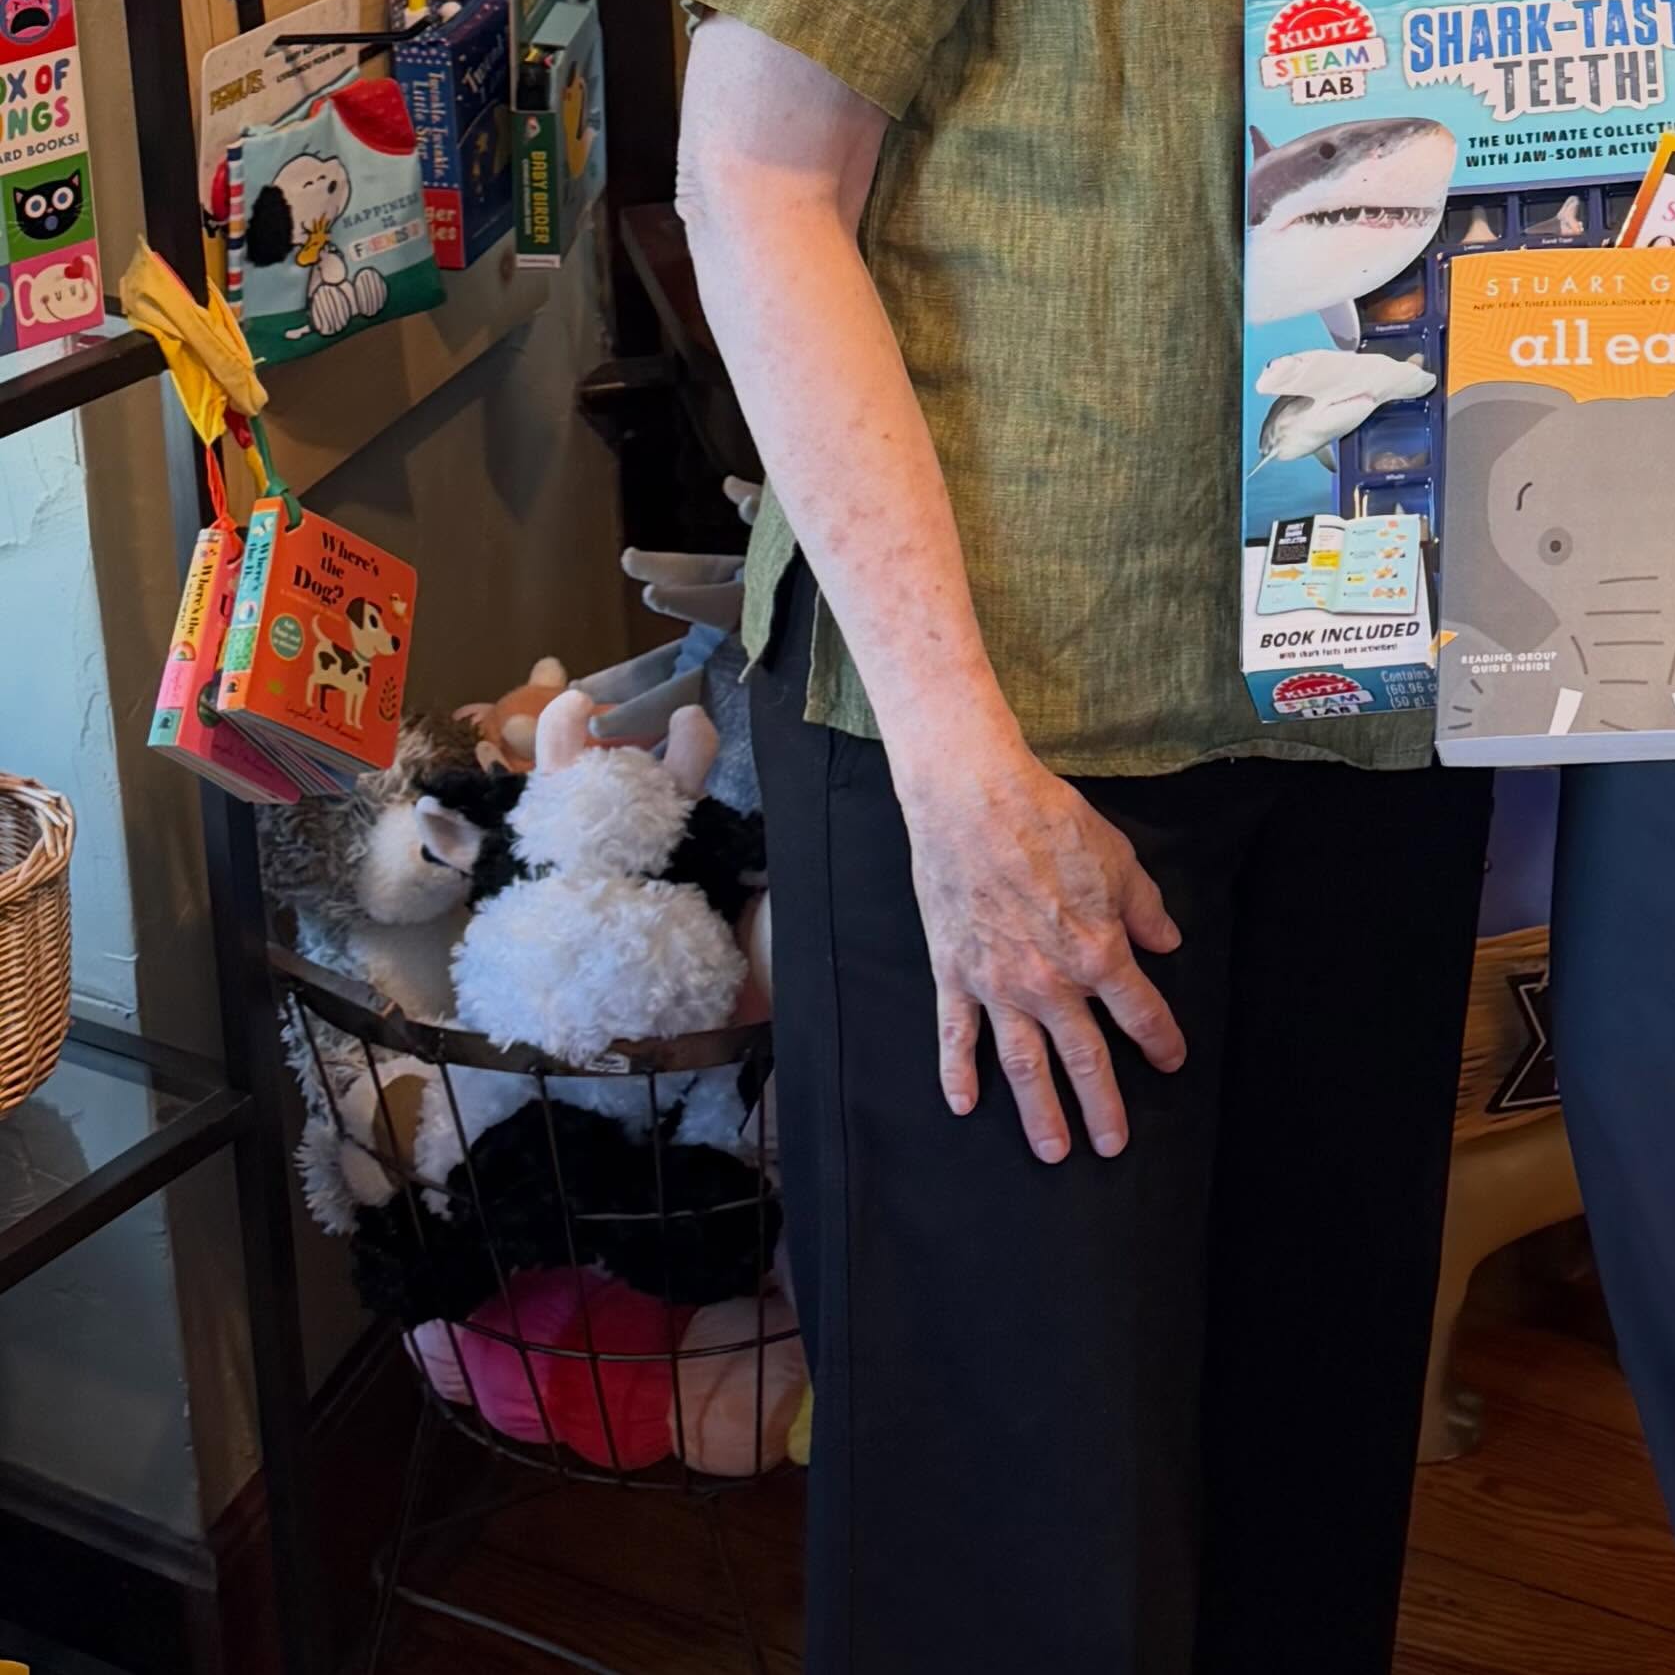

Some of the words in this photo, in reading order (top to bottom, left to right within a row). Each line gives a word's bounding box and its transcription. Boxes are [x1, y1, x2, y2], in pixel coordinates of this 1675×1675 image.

[1280, 18, 1360, 49] KLUTZ
[1276, 45, 1370, 77] STEAM
[35, 58, 70, 95] OF
[1305, 77, 1354, 98] LAB
[1493, 49, 1659, 114] TEETH!
[27, 132, 80, 156] BOOKS!
[1469, 136, 1499, 149] THE
[1505, 127, 1588, 146] ULTIMATE
[1466, 153, 1509, 167] WITH
[1514, 143, 1603, 164] JAW-SOME
[530, 150, 548, 190] BABY
[532, 191, 551, 245] BIRDER
[1486, 275, 1625, 296] STUART
[1509, 319, 1593, 366] all
[321, 532, 379, 577] Where's
[320, 556, 345, 580] the
[293, 564, 345, 606] Dog?
[1260, 630, 1315, 648] BOOK
[1321, 622, 1420, 643] INCLUDED
[1461, 653, 1513, 665] READING
[1518, 651, 1558, 663] GROUP
[1472, 664, 1507, 674] GUIDE
[1512, 661, 1552, 672] INSIDE
[1381, 669, 1430, 683] Contains
[1285, 683, 1346, 700] KLUTZ
[1312, 706, 1353, 716] LAB
